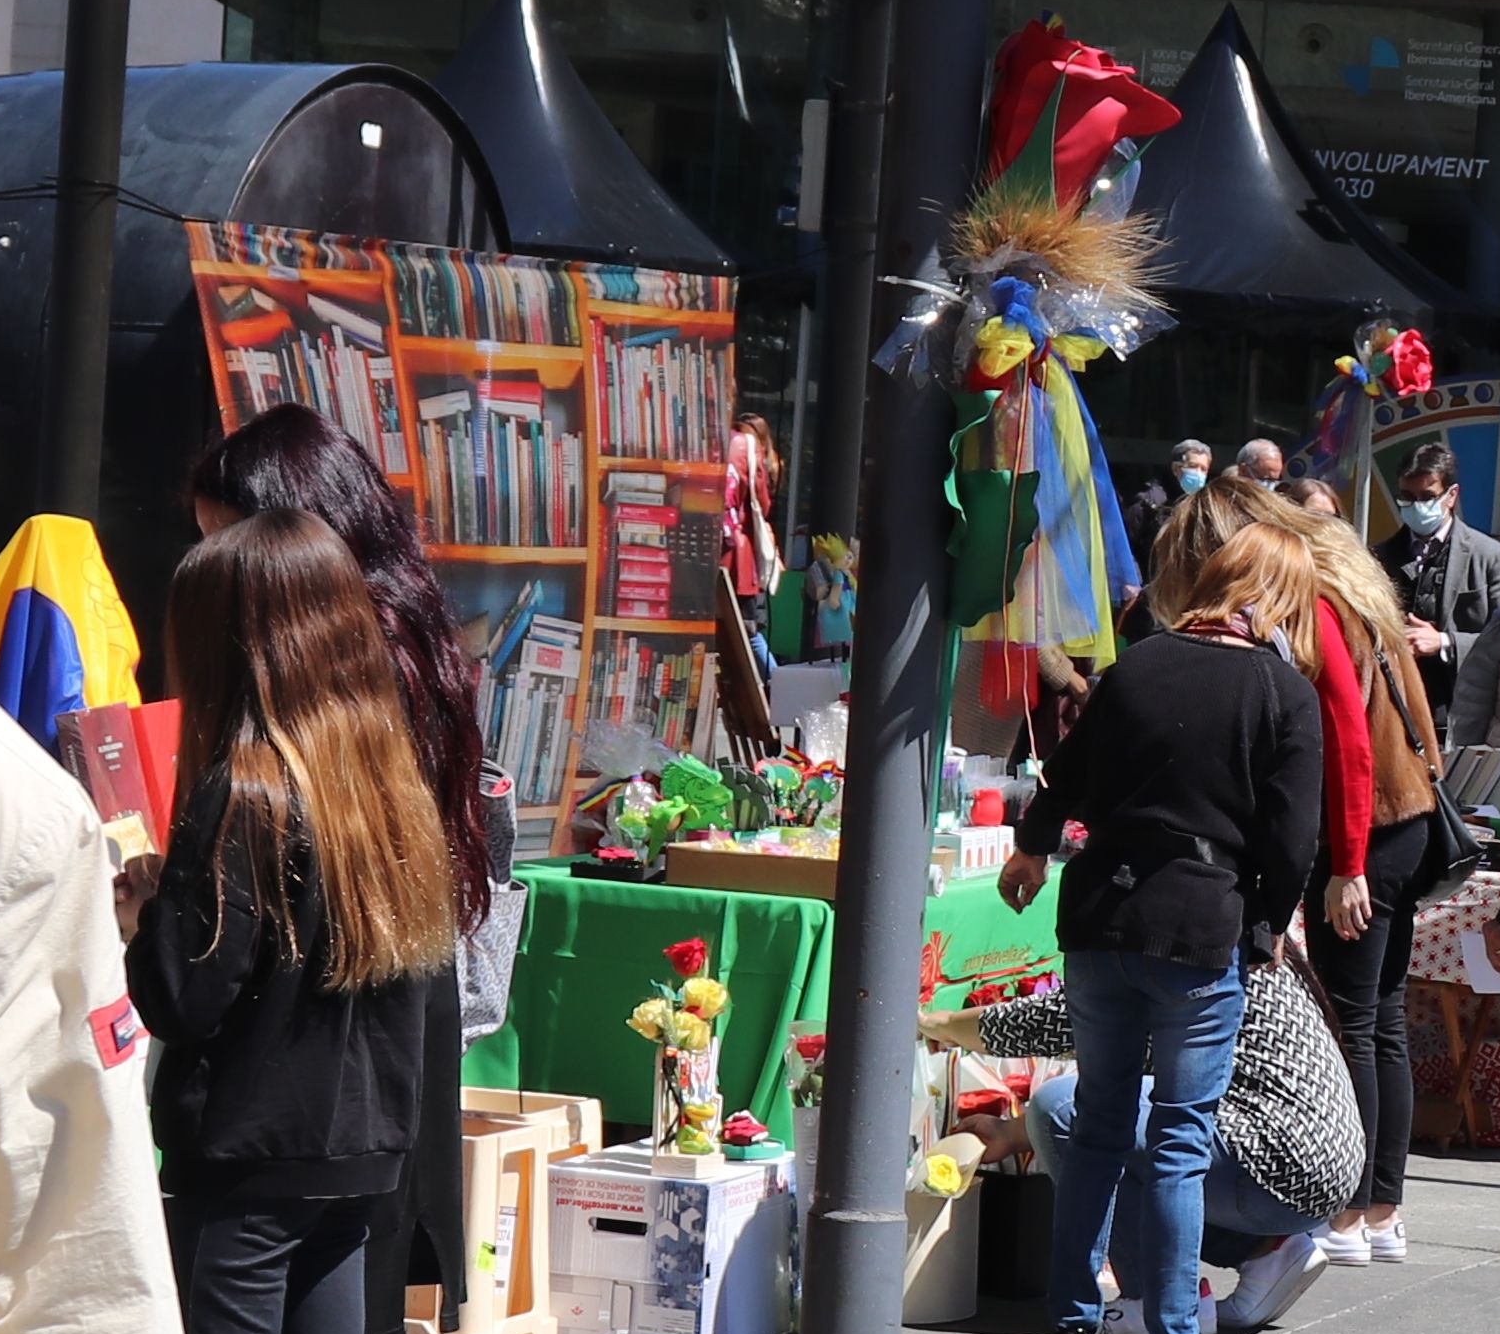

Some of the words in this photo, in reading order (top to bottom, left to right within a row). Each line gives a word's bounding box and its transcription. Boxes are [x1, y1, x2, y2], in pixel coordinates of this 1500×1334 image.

[1407, 53, 1493, 68] Iberoamericana
[1404, 90, 1497, 105] Ibero-Americana
[1311, 148, 1490, 180] NVOLUPAMENT
